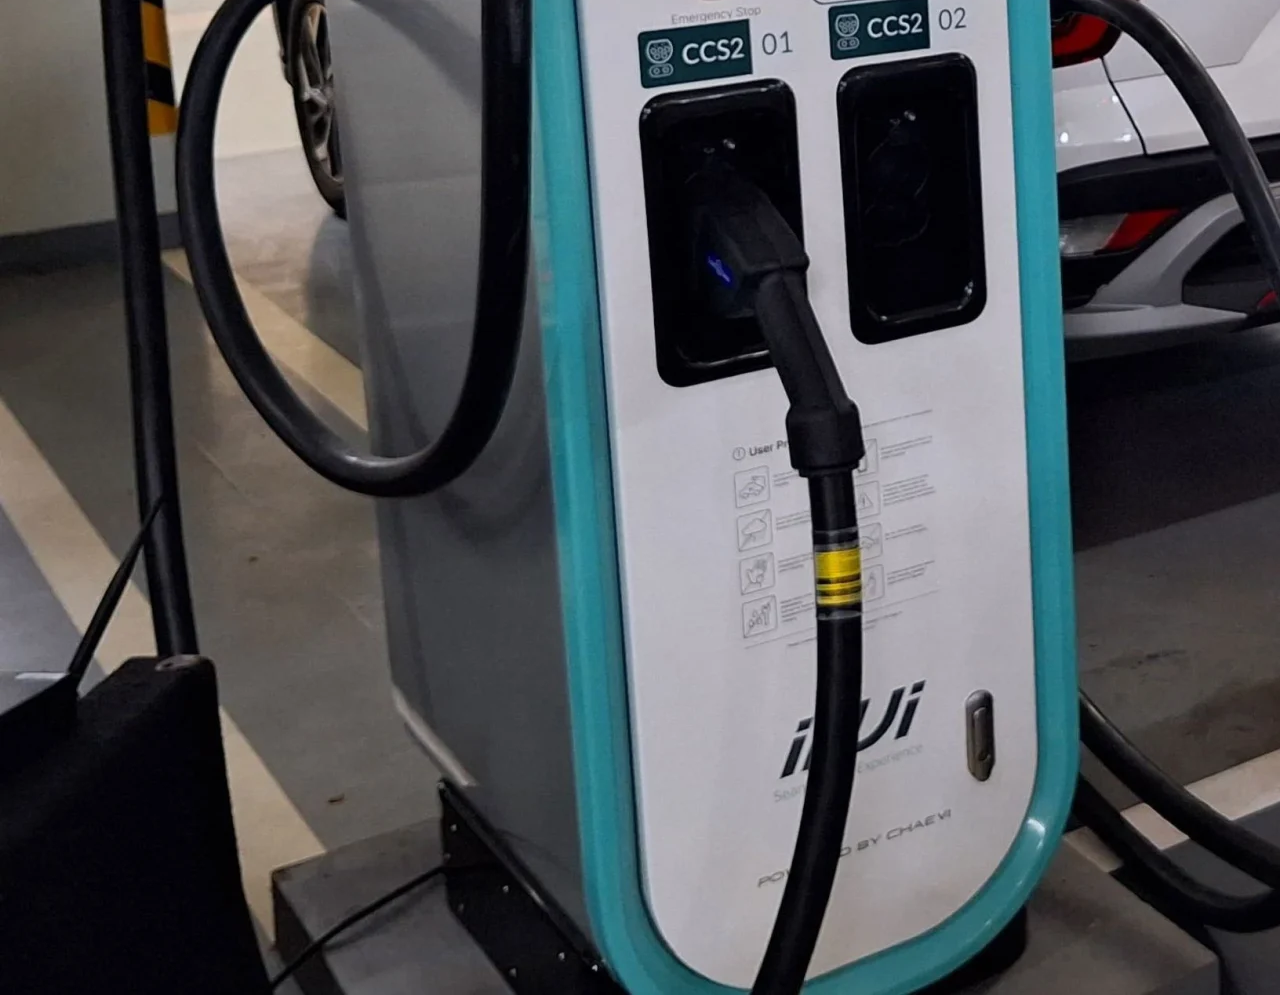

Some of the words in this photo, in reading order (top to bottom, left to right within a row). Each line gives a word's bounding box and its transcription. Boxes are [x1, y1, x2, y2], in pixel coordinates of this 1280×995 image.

[671, 10, 733, 24] Emergency
[736, 6, 761, 18] Stop
[867, 12, 923, 40] CCS2
[938, 7, 967, 31] 02
[682, 37, 745, 65] CCS2
[762, 32, 793, 56] 01
[749, 442, 774, 457] User
[857, 835, 882, 852] BY
